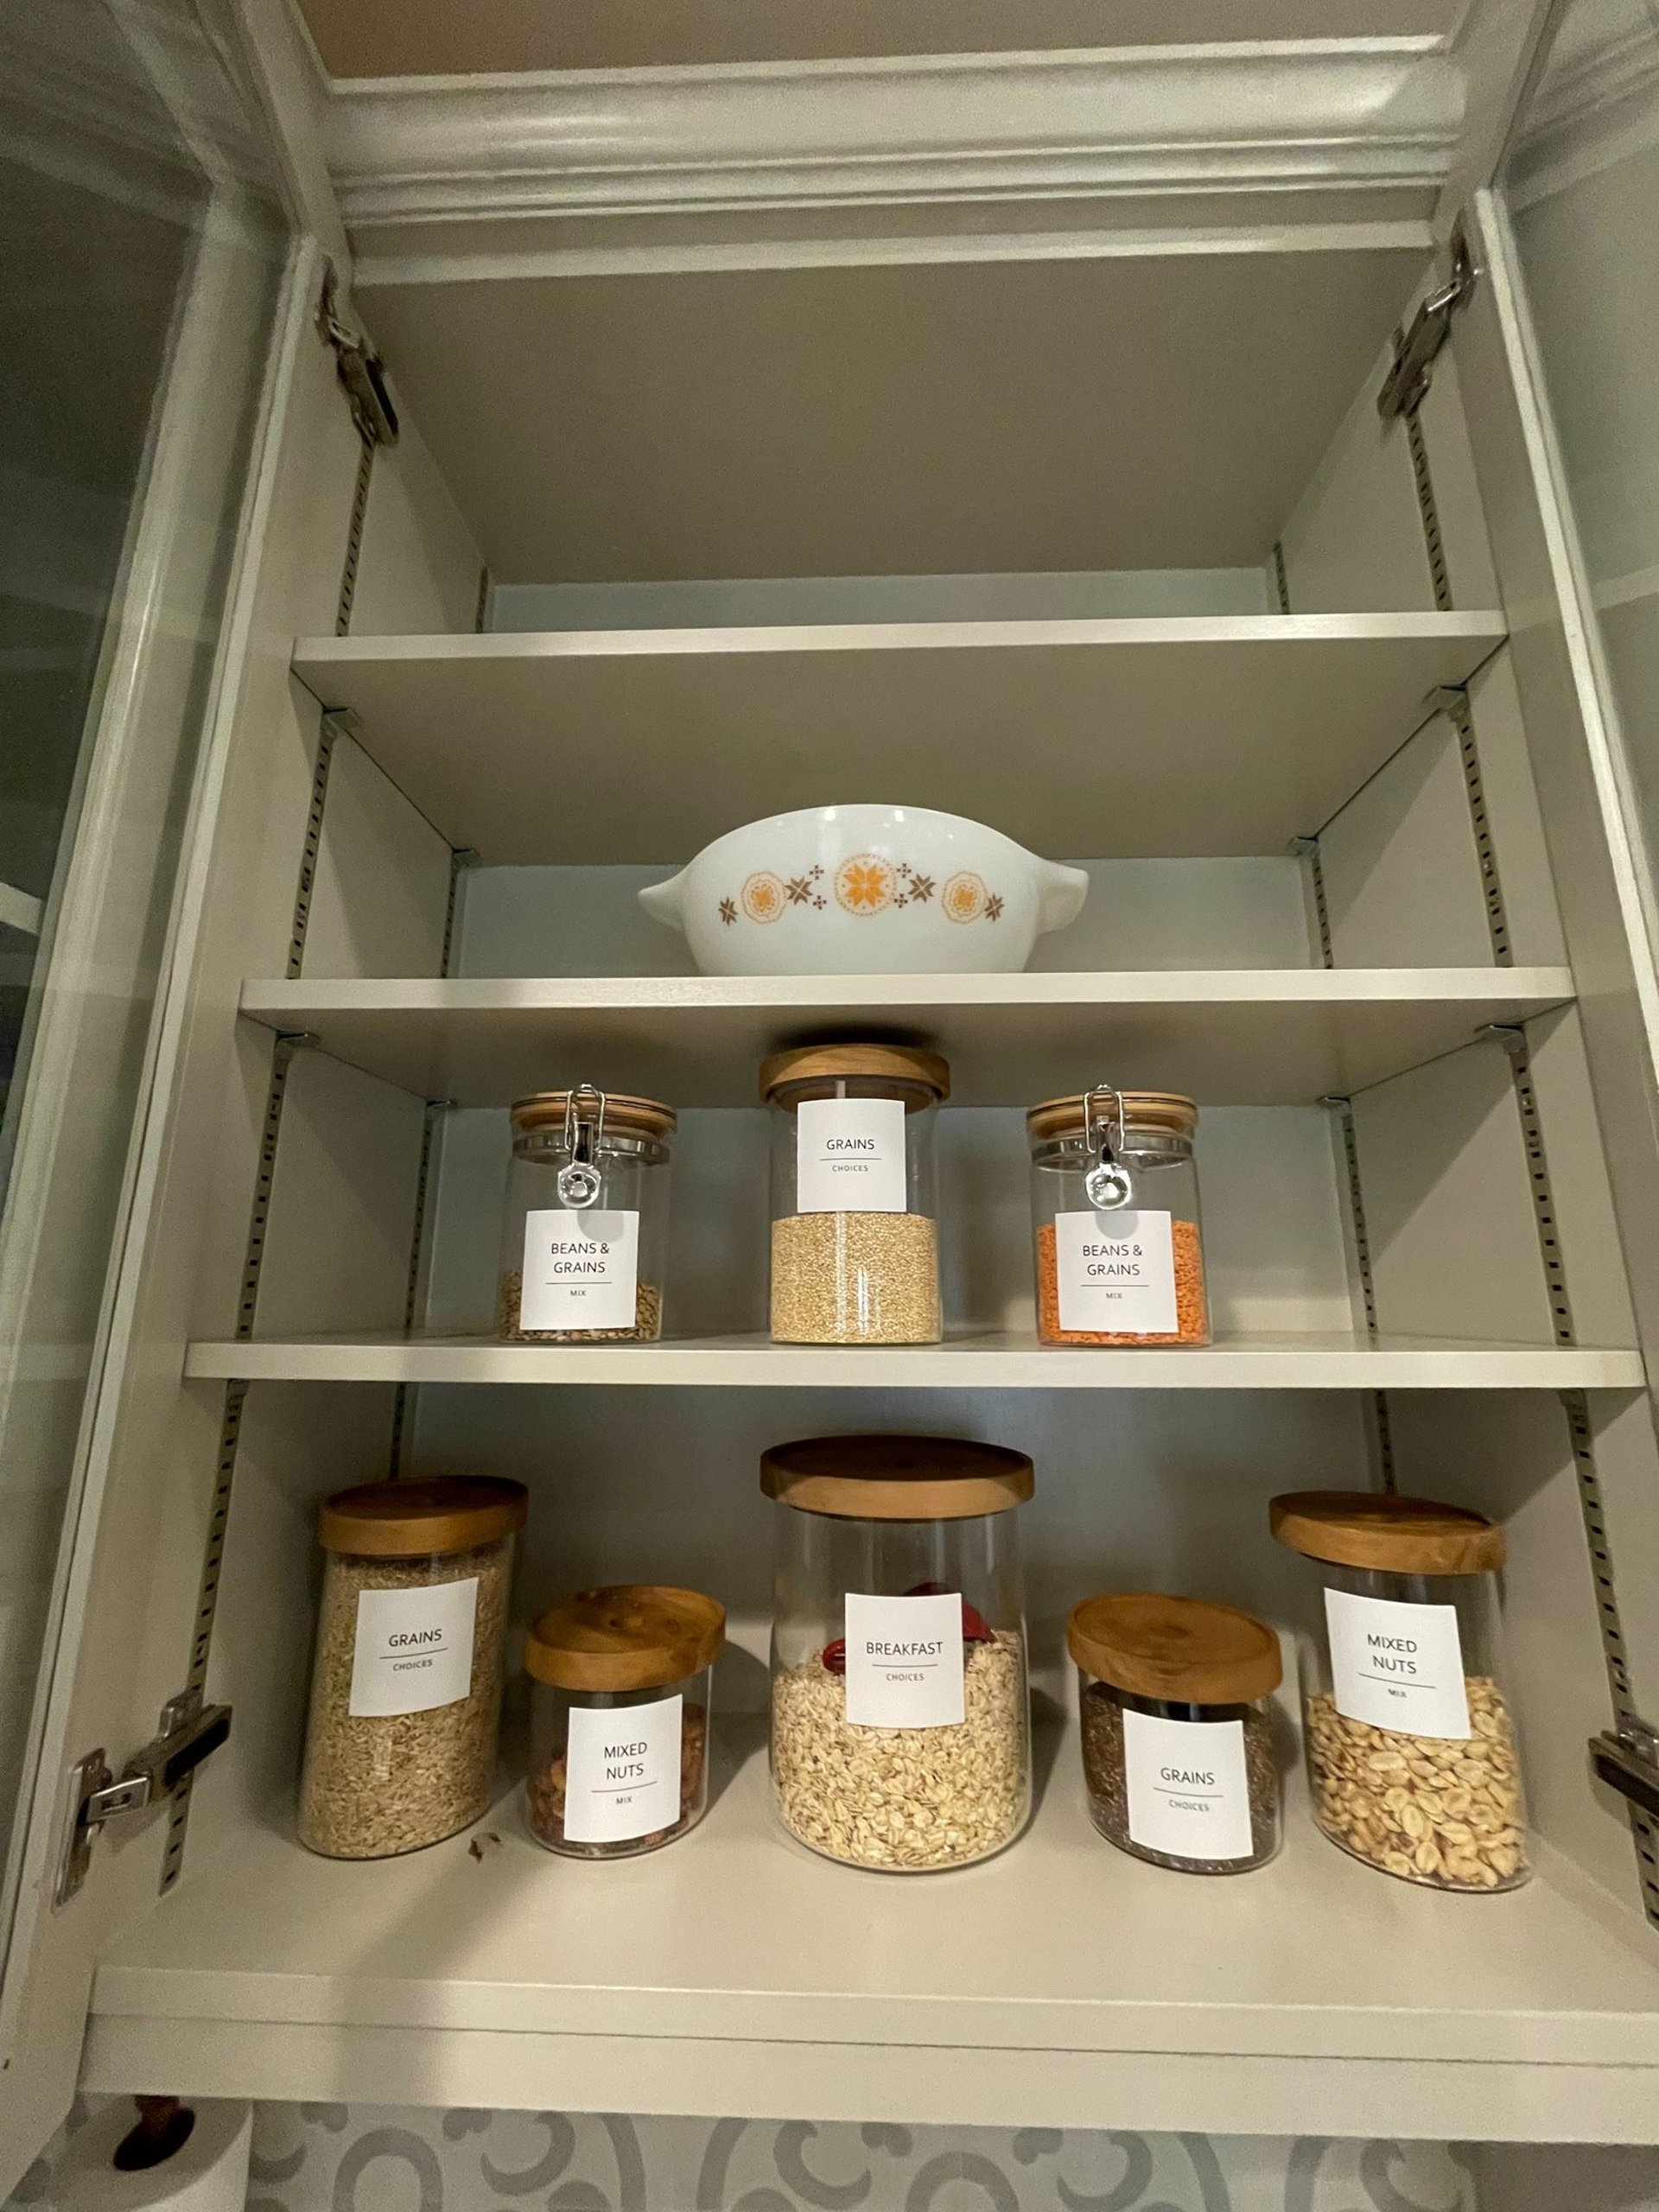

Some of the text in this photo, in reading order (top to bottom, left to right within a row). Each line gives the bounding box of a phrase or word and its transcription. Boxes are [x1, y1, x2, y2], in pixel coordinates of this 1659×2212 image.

[825, 1138, 875, 1151] GRAINS
[830, 1164, 869, 1173] CHOICES
[550, 1242, 611, 1255] BEANS &
[1082, 1243, 1143, 1257] BEANS &
[553, 1261, 607, 1274] GRAINS
[1086, 1263, 1141, 1276] GRAINS
[388, 1628, 443, 1648] GRAINS
[1367, 1633, 1418, 1654] MIXED
[866, 1641, 944, 1656] BREAKFAST
[392, 1658, 434, 1672] CHOICES
[1372, 1654, 1418, 1675] NUTS
[886, 1673, 925, 1682] CHOICES
[603, 1741, 648, 1759] MIXED
[606, 1762, 645, 1781] NUTS
[1160, 1766, 1216, 1786] GRAINS
[615, 1796, 632, 1805] MIX
[1168, 1799, 1211, 1813] CHOICES
